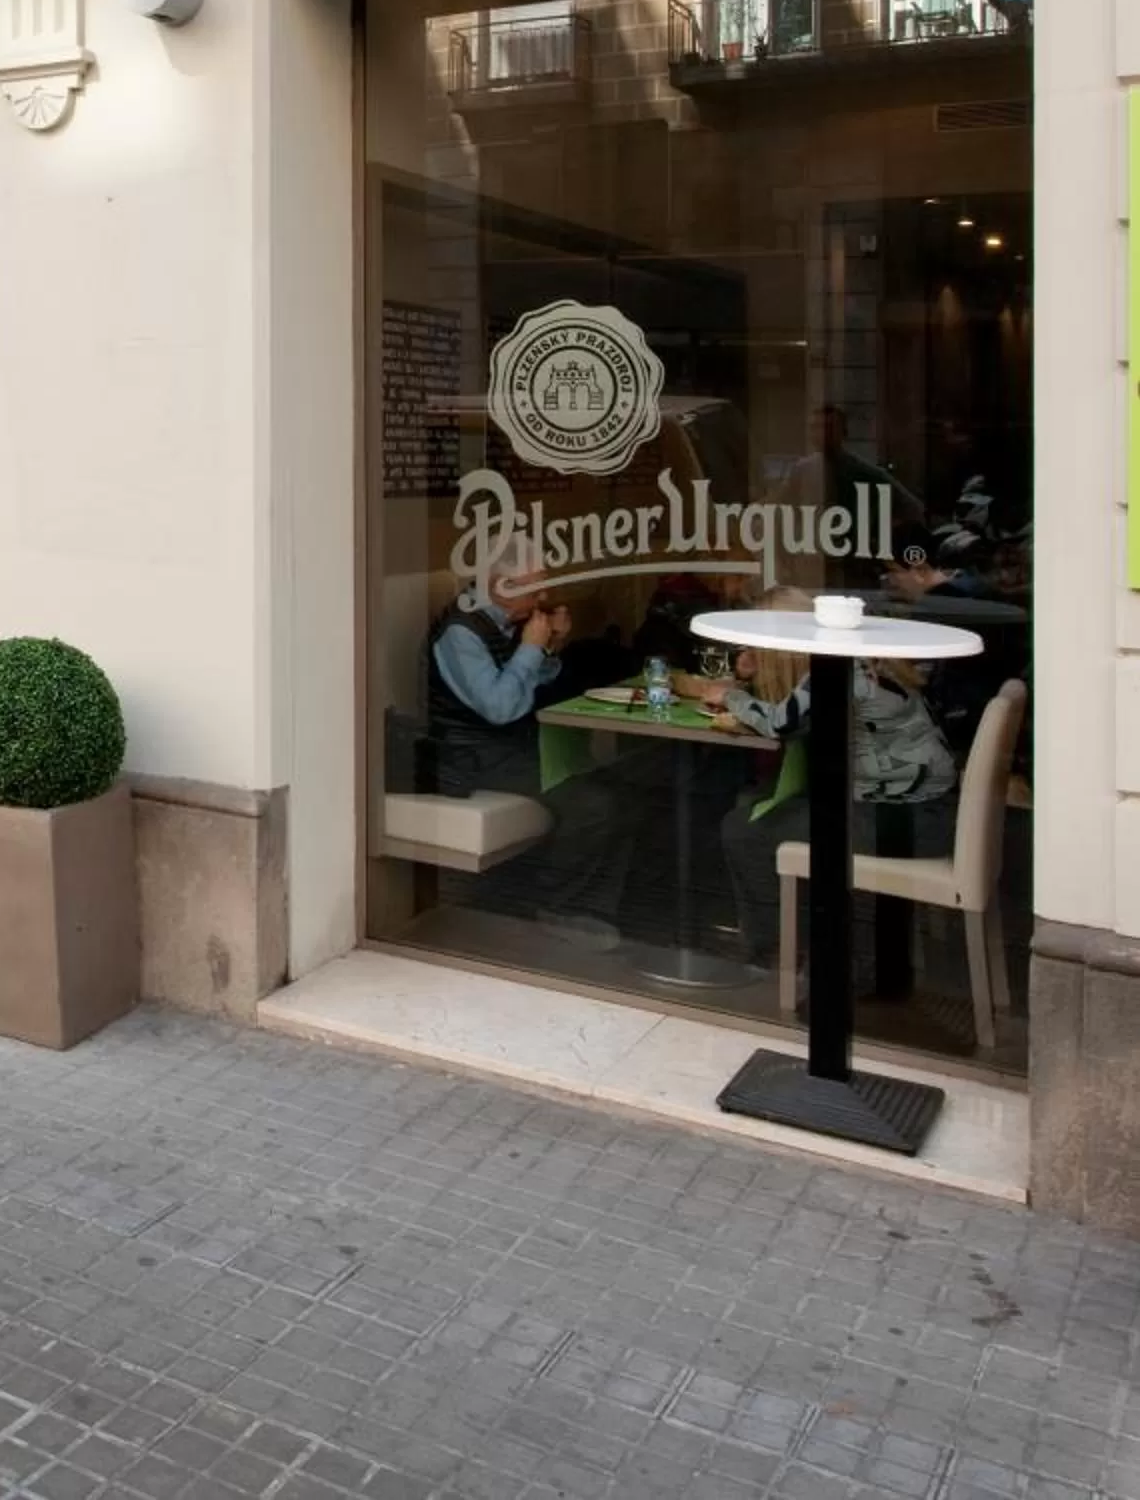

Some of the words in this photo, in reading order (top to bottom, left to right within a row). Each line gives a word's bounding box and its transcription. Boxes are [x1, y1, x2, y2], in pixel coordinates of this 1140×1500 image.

[575, 331, 633, 393] PRAZDROJ
[525, 413, 544, 433] OD
[544, 430, 587, 448] ROKU
[590, 413, 624, 443] 1842
[450, 468, 664, 613] Pilsner
[658, 467, 894, 590] Urquell
